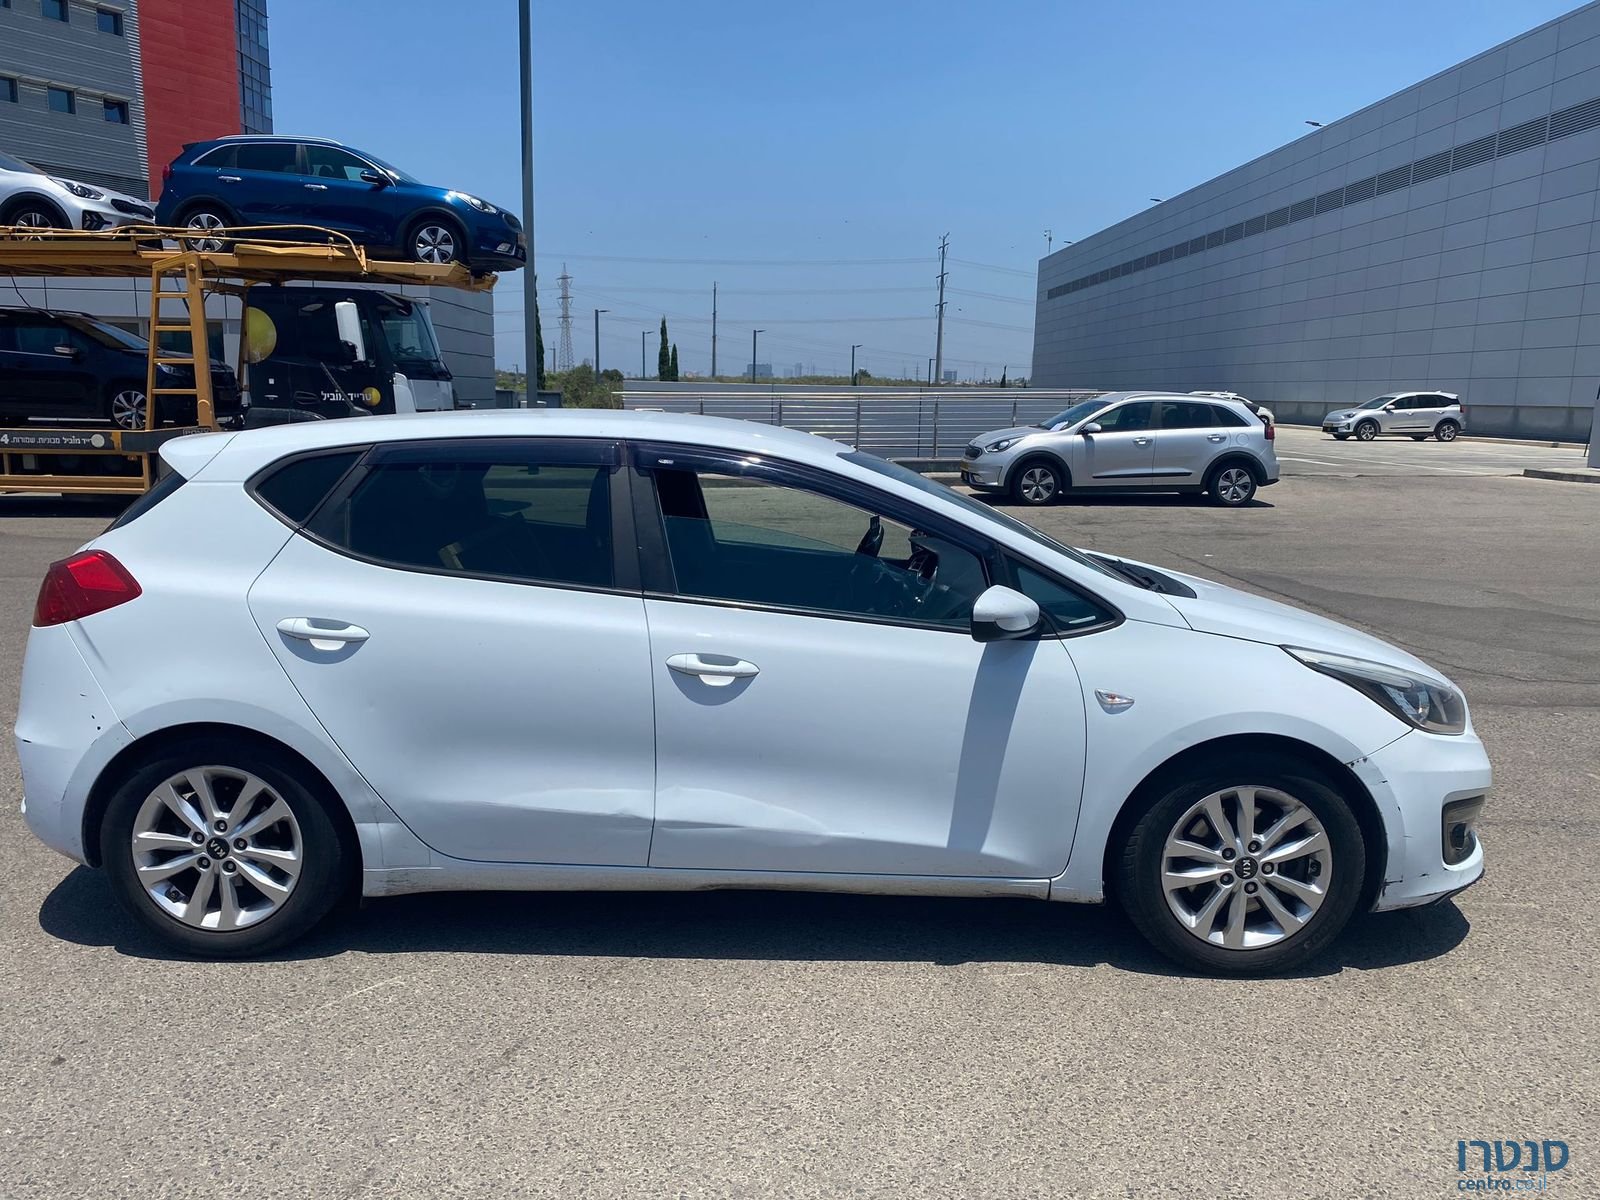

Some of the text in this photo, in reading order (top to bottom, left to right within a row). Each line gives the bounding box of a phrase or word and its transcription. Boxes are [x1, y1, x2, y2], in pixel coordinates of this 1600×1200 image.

[348, 392, 372, 401] טרייד
[210, 840, 226, 857] KIA
[1242, 859, 1251, 877] KIA
